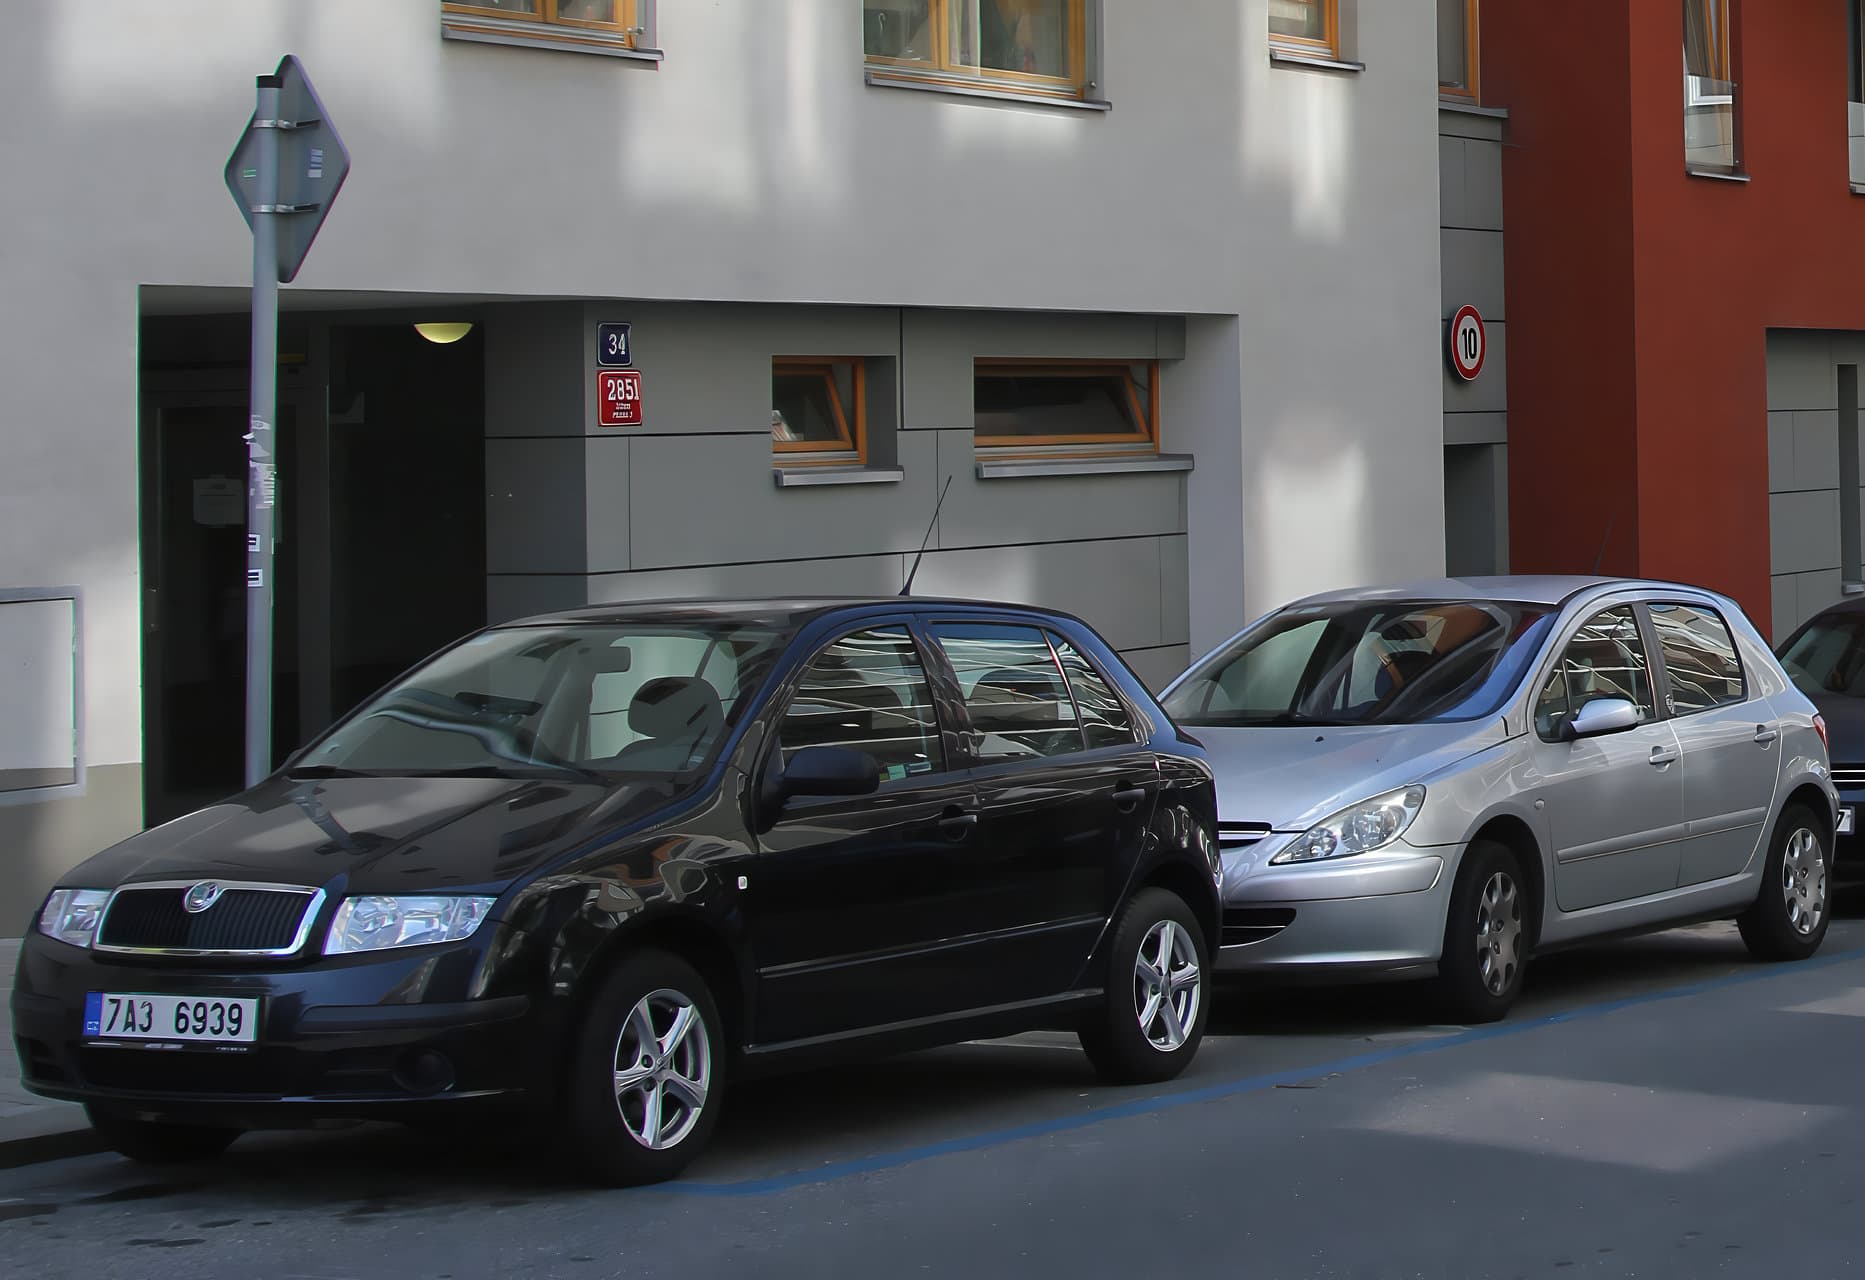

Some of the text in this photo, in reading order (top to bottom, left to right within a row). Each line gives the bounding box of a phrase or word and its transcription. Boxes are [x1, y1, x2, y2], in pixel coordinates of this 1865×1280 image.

[609, 333, 626, 355] 34
[1462, 328, 1477, 360] 10
[608, 379, 640, 401] 2851
[105, 998, 243, 1037] 7A3 6939
